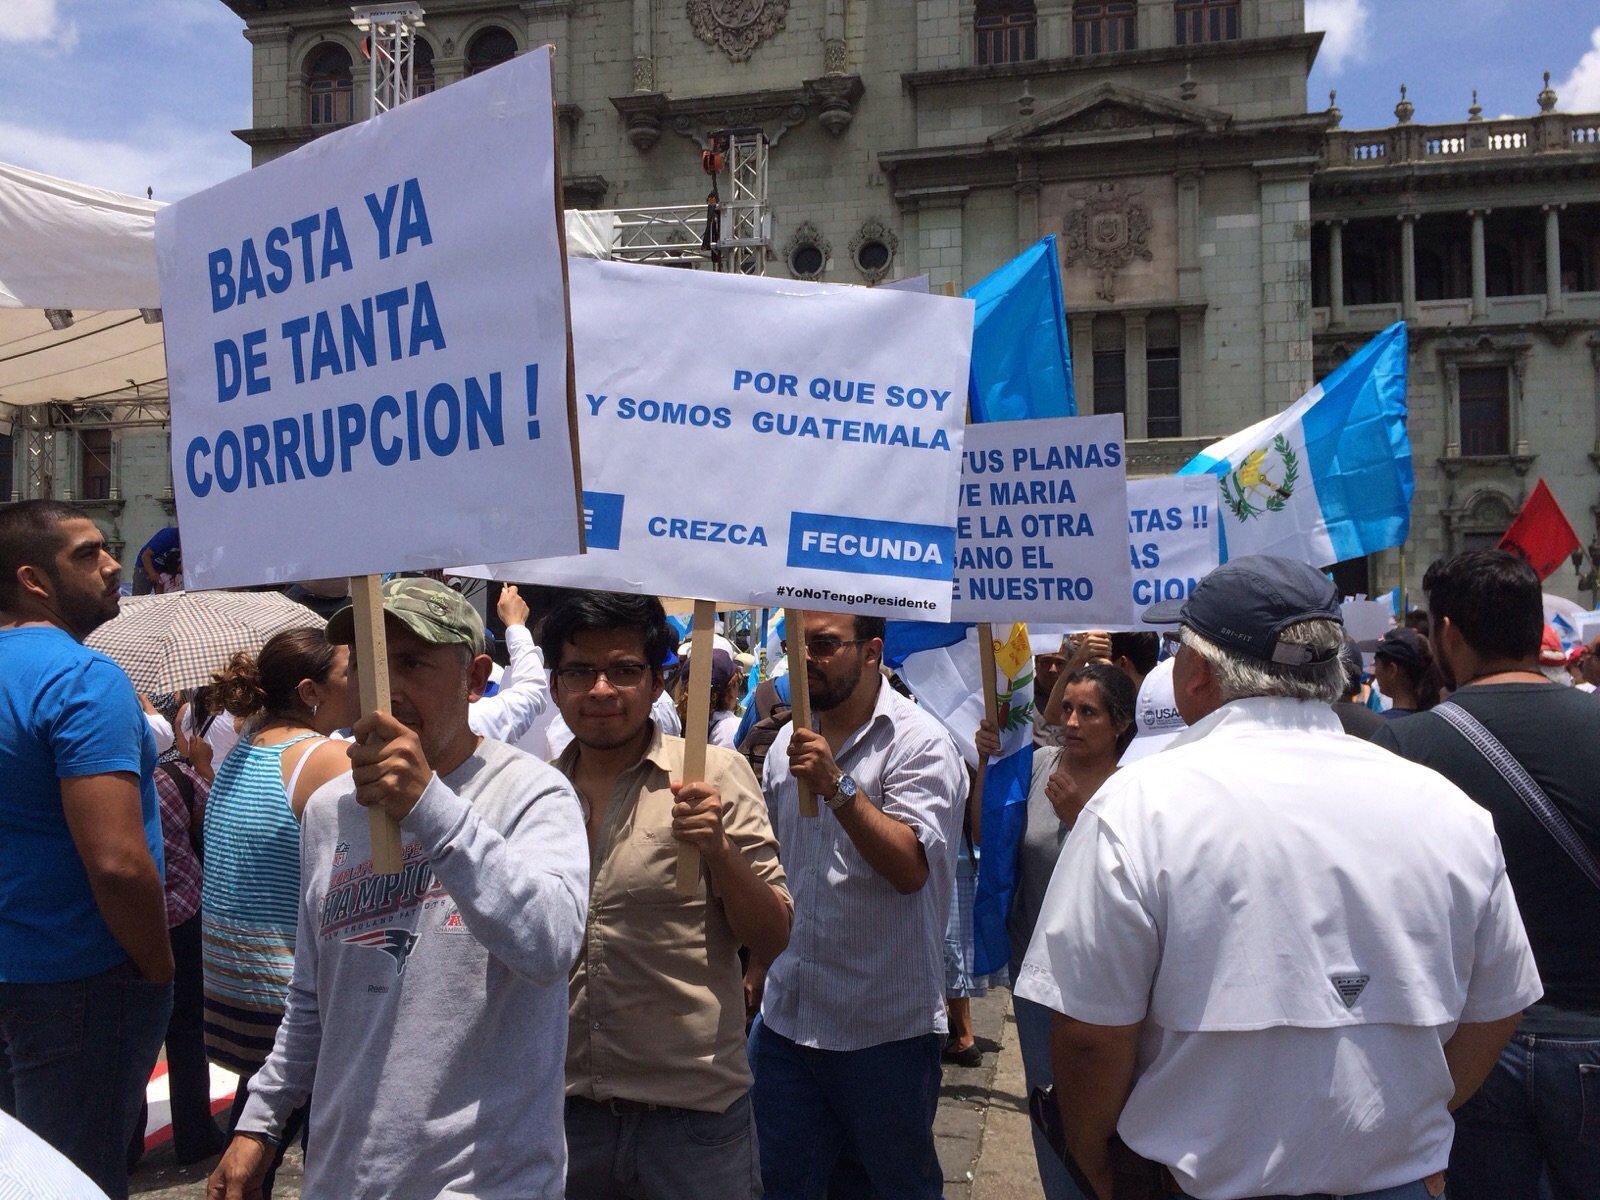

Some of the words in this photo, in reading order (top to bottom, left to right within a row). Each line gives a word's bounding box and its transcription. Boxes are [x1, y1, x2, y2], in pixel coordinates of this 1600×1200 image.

[208, 206, 353, 313] BASTA
[364, 178, 433, 260] YA
[214, 328, 271, 403] DE
[282, 280, 446, 384] TANTA
[733, 370, 798, 397] POR
[809, 377, 876, 404] QUE
[886, 385, 951, 411] SOY
[185, 372, 504, 498] CORRUPCION
[526, 363, 541, 440] !
[586, 394, 607, 416] Y
[617, 397, 732, 429] SOMOS
[752, 411, 951, 451] GUATEMALA
[1013, 442, 1121, 472] PLANAS
[989, 480, 1076, 505] MARIA
[980, 516, 1013, 538] LA
[1021, 513, 1094, 538] OTRA
[1129, 507, 1183, 533] TAS
[1193, 505, 1208, 529] !!
[648, 516, 768, 547] CREZCA
[801, 531, 943, 564] FECUNDA
[953, 547, 1013, 570] ANO
[1022, 545, 1053, 569] EL
[776, 585, 937, 610] #YoNoTengoPresidente
[969, 577, 1093, 601] NUESTRO
